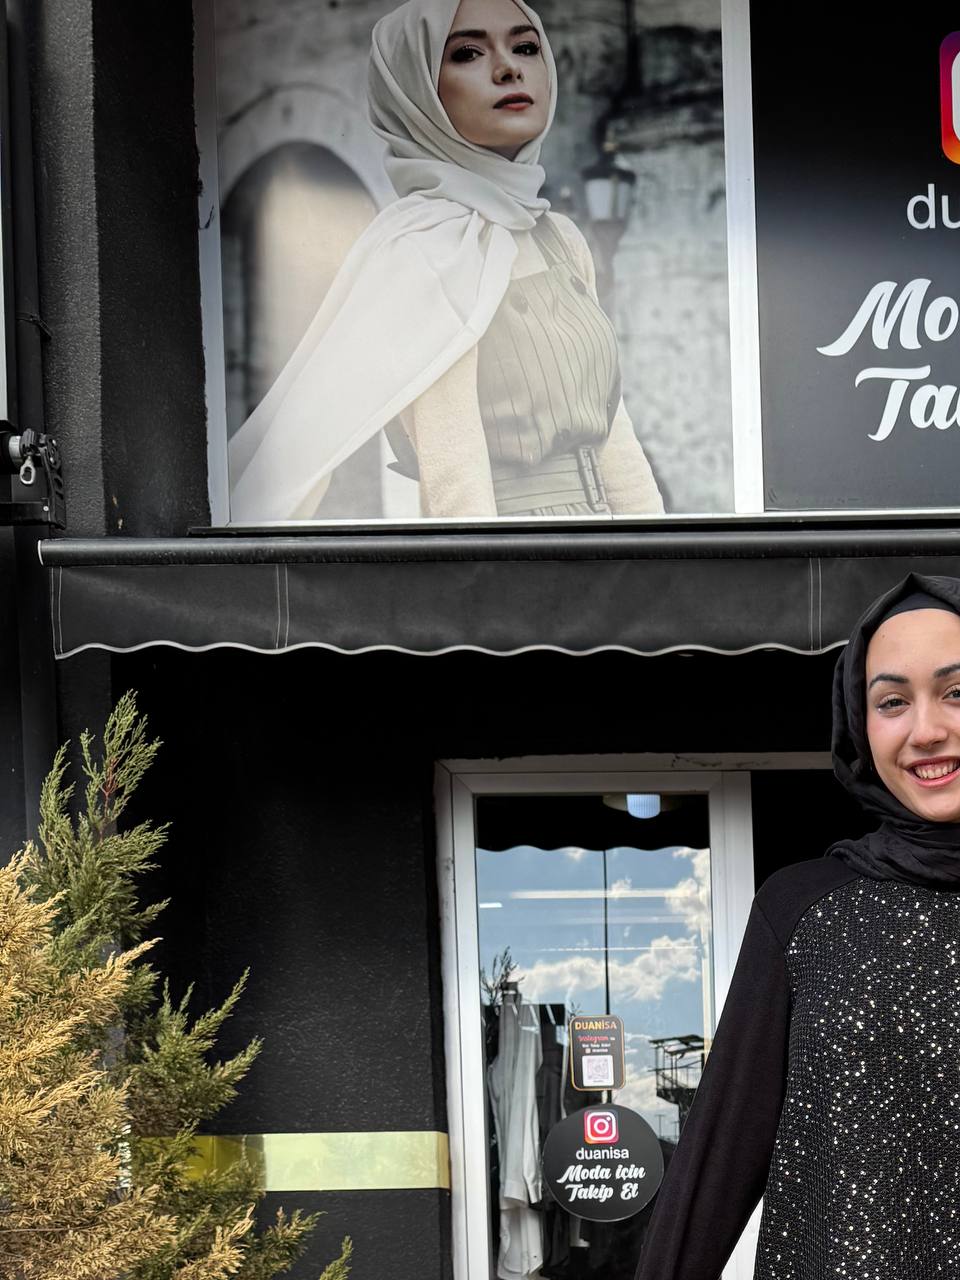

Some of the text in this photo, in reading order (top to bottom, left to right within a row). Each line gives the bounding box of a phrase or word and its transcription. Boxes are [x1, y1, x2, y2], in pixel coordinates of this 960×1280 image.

[575, 1146, 629, 1160] duanisa
[556, 1163, 646, 1184] Moda için
[564, 1182, 639, 1203] Takip Et
